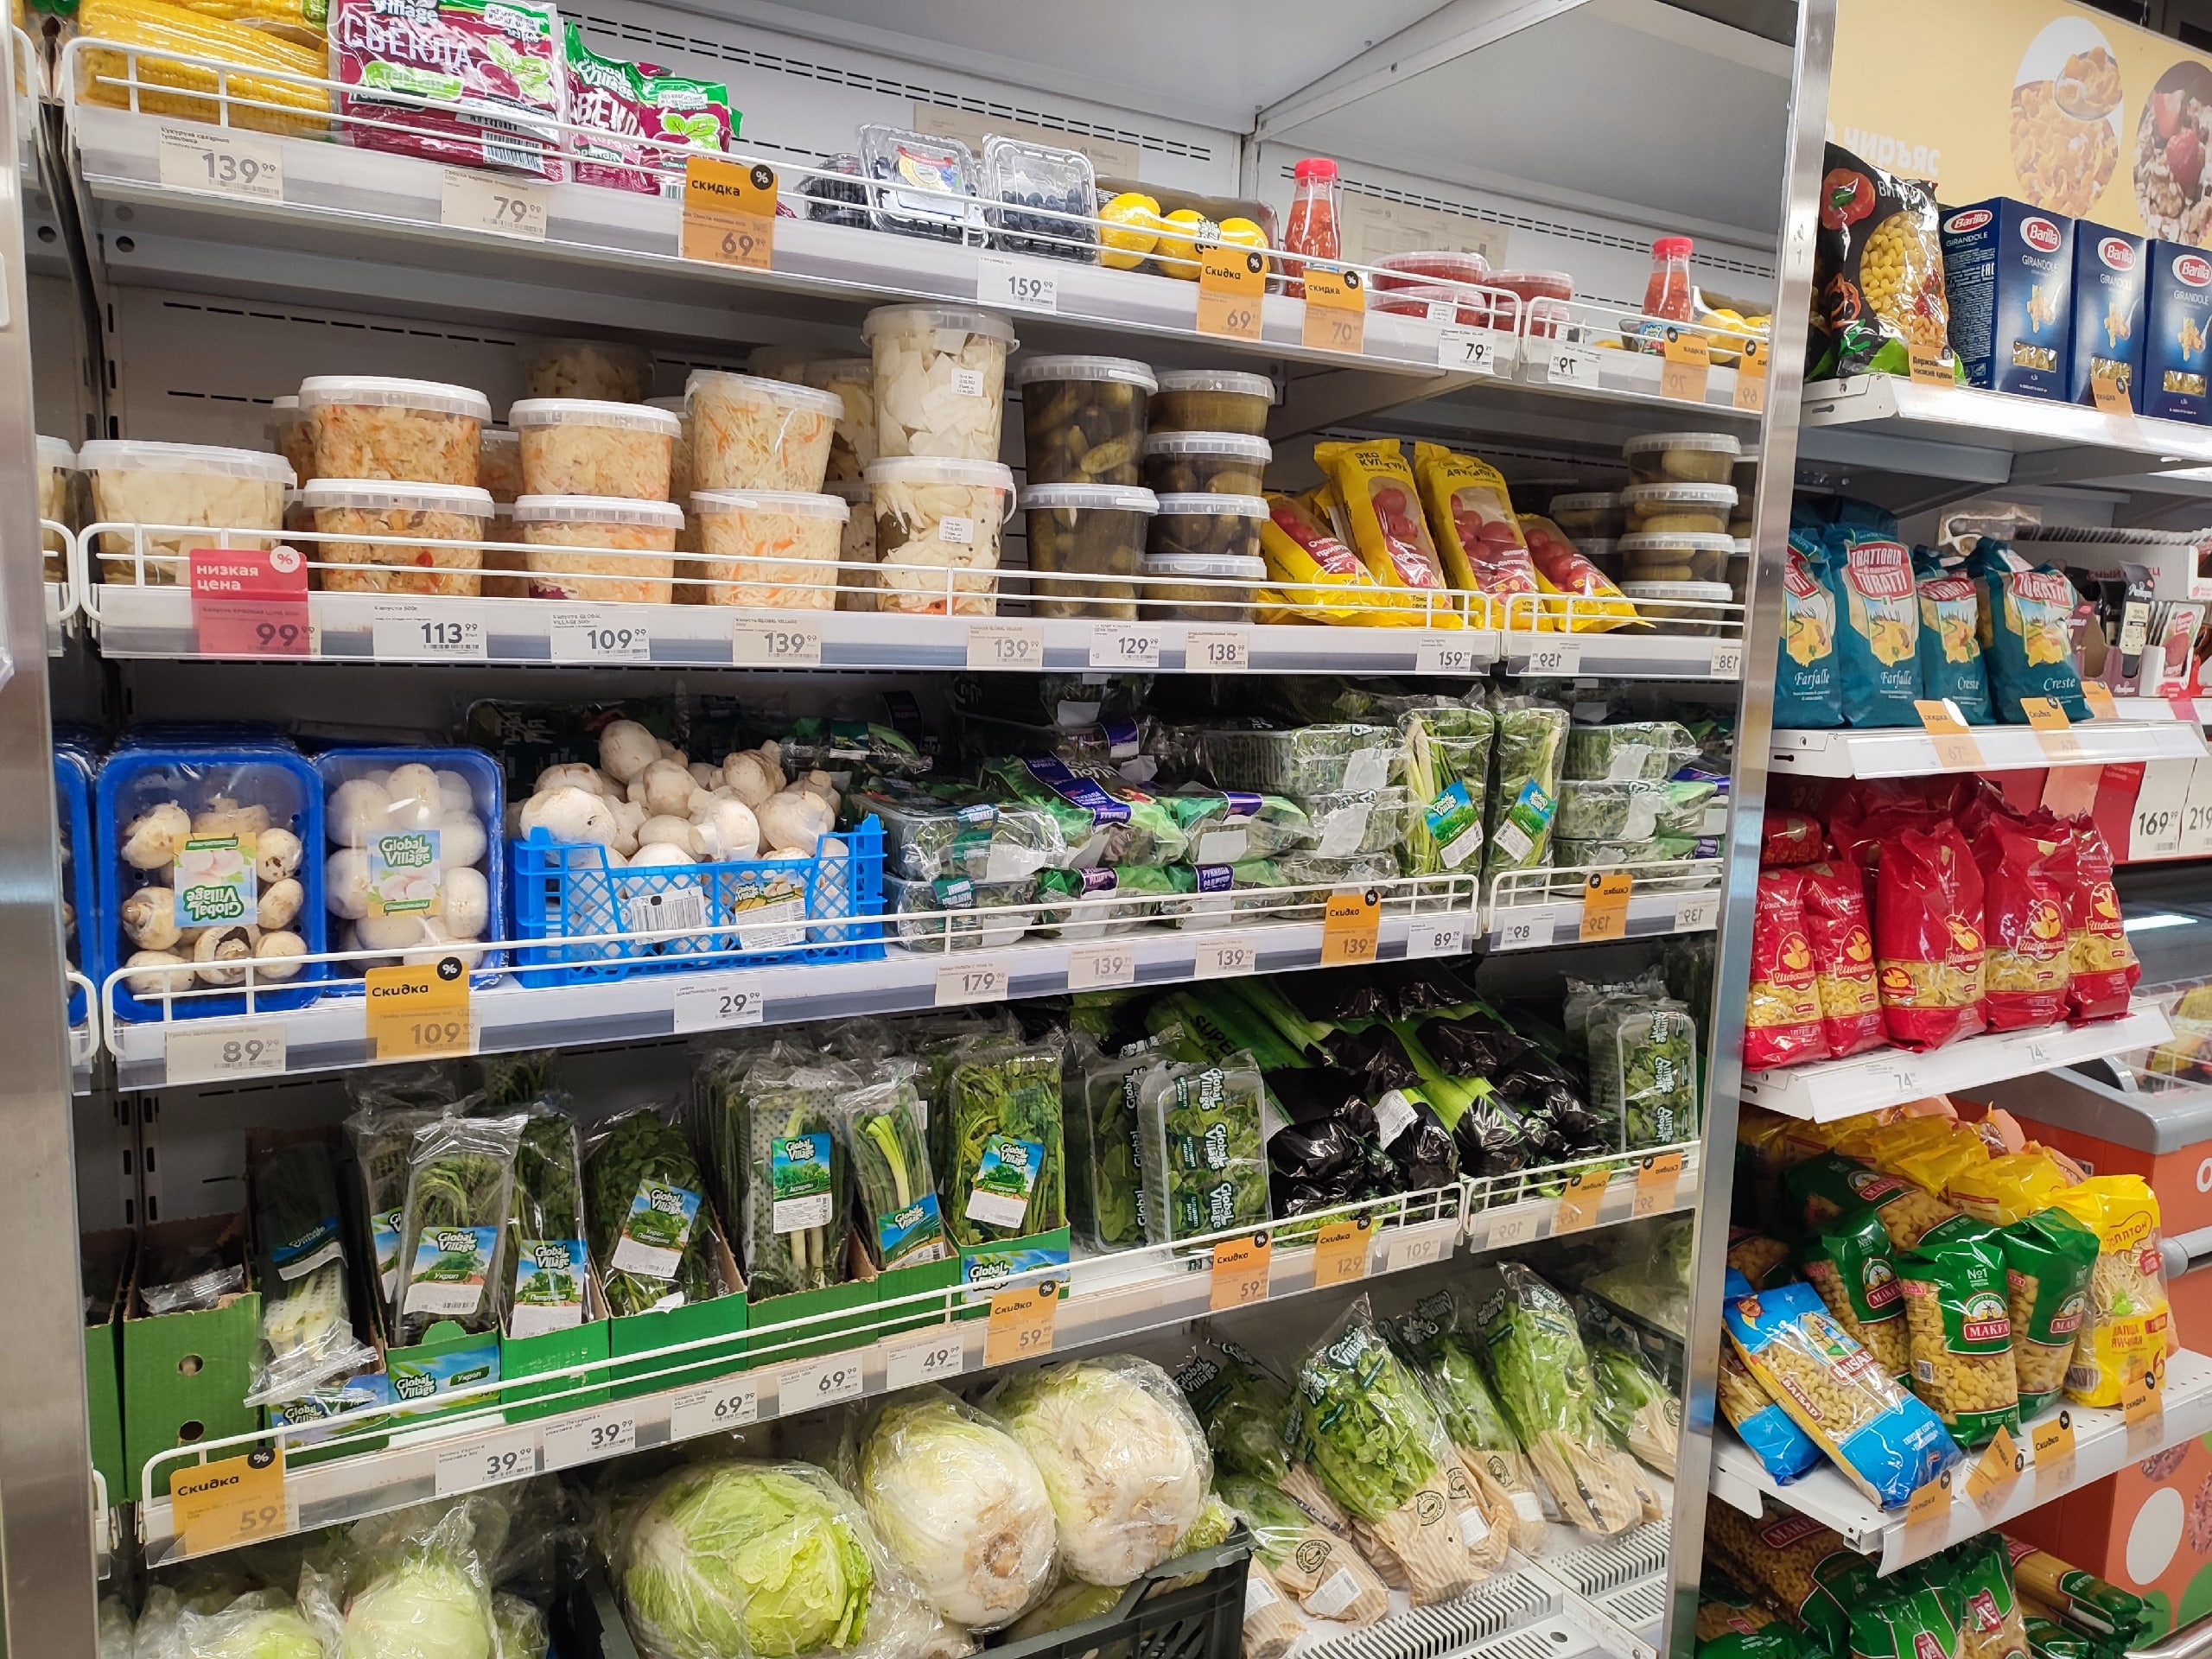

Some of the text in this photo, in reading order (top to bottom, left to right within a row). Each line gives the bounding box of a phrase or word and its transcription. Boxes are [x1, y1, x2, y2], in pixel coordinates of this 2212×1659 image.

[202, 152, 276, 183] 139 99
[493, 196, 542, 223] 79 99
[1955, 213, 1987, 229] Barilla
[721, 232, 753, 256] 69
[1946, 232, 1987, 247] GIRANDOLE
[2030, 225, 2058, 245] Barilla
[2107, 245, 2133, 264] Barilla
[1205, 265, 1241, 280] Скидка
[2181, 263, 2211, 280] Barilla
[1008, 276, 1042, 297] 159
[1227, 308, 1251, 328] 69
[1332, 322, 1352, 342] 70
[1466, 343, 1484, 360] 79
[1852, 547, 1901, 569] TRATTORIA
[196, 563, 259, 577] низкая
[197, 579, 241, 592] цена
[1858, 570, 1908, 594] TURATTI
[255, 622, 299, 646] 99
[421, 622, 462, 644] 113
[587, 629, 632, 650] 109
[764, 632, 804, 653] 139
[994, 639, 1028, 658] 139
[1118, 637, 1148, 654] 129
[1208, 643, 1236, 661] 138
[1439, 652, 1462, 666] 159
[1795, 669, 1830, 689] Farfalle
[1880, 671, 1912, 689] Farfalle
[1957, 677, 1979, 690] Creste
[2044, 677, 2075, 691] Creste
[2139, 811, 2168, 836] 169
[381, 836, 429, 853] Global
[385, 850, 430, 865] Village
[186, 887, 238, 903] Village
[189, 903, 242, 918] Global
[1330, 908, 1360, 917] Скидка
[1343, 938, 1368, 954] 139
[1434, 932, 1451, 946] 89
[1093, 957, 1122, 975] 139
[1217, 950, 1243, 966] 139
[372, 983, 429, 998] Скидка
[962, 973, 995, 991] 179
[720, 995, 747, 1014] 29
[410, 1022, 461, 1046] 109
[223, 1039, 264, 1063] 89
[1209, 1068, 1223, 1108] Global
[1894, 1072, 1912, 1089] 74
[1199, 1071, 1211, 1109] Village
[785, 1138, 814, 1152] Global
[788, 1147, 815, 1160] Village
[1001, 1143, 1028, 1158] Global
[1205, 1130, 1217, 1170] Village
[1214, 1123, 1227, 1167] Global
[1001, 1153, 1027, 1166] Village
[651, 1189, 683, 1205] Global
[1219, 1182, 1234, 1226] Global
[652, 1198, 681, 1215] Village
[895, 1204, 924, 1224] Global
[1211, 1190, 1221, 1229] Village
[899, 1211, 924, 1230] Village
[438, 1232, 478, 1244] Global
[439, 1241, 475, 1253] Village
[1320, 1233, 1351, 1244] Скидка
[534, 1245, 570, 1259] Global
[1217, 1252, 1249, 1264] Скидка
[1406, 1242, 1431, 1259] 109
[537, 1255, 569, 1268] Village
[969, 1262, 1008, 1278] Global
[1337, 1256, 1361, 1274] 129
[1241, 1281, 1259, 1298] 59
[995, 1300, 1032, 1315] Скидка
[1970, 1321, 2009, 1336] MAKFA
[1019, 1329, 1042, 1347] 59
[924, 1349, 948, 1367] 49
[457, 1370, 481, 1382] Укроп
[818, 1371, 845, 1391] 69
[1173, 1357, 1206, 1387] Global
[1187, 1363, 1218, 1392] Village
[397, 1375, 435, 1389] Global
[399, 1384, 436, 1400] Village
[1783, 1379, 1821, 1418] BAISAD
[284, 1405, 323, 1419] Global
[714, 1396, 742, 1416] 69
[591, 1420, 633, 1446] 39 99
[486, 1452, 517, 1475] 39
[178, 1475, 239, 1497] Скидка
[239, 1505, 277, 1532] 59
